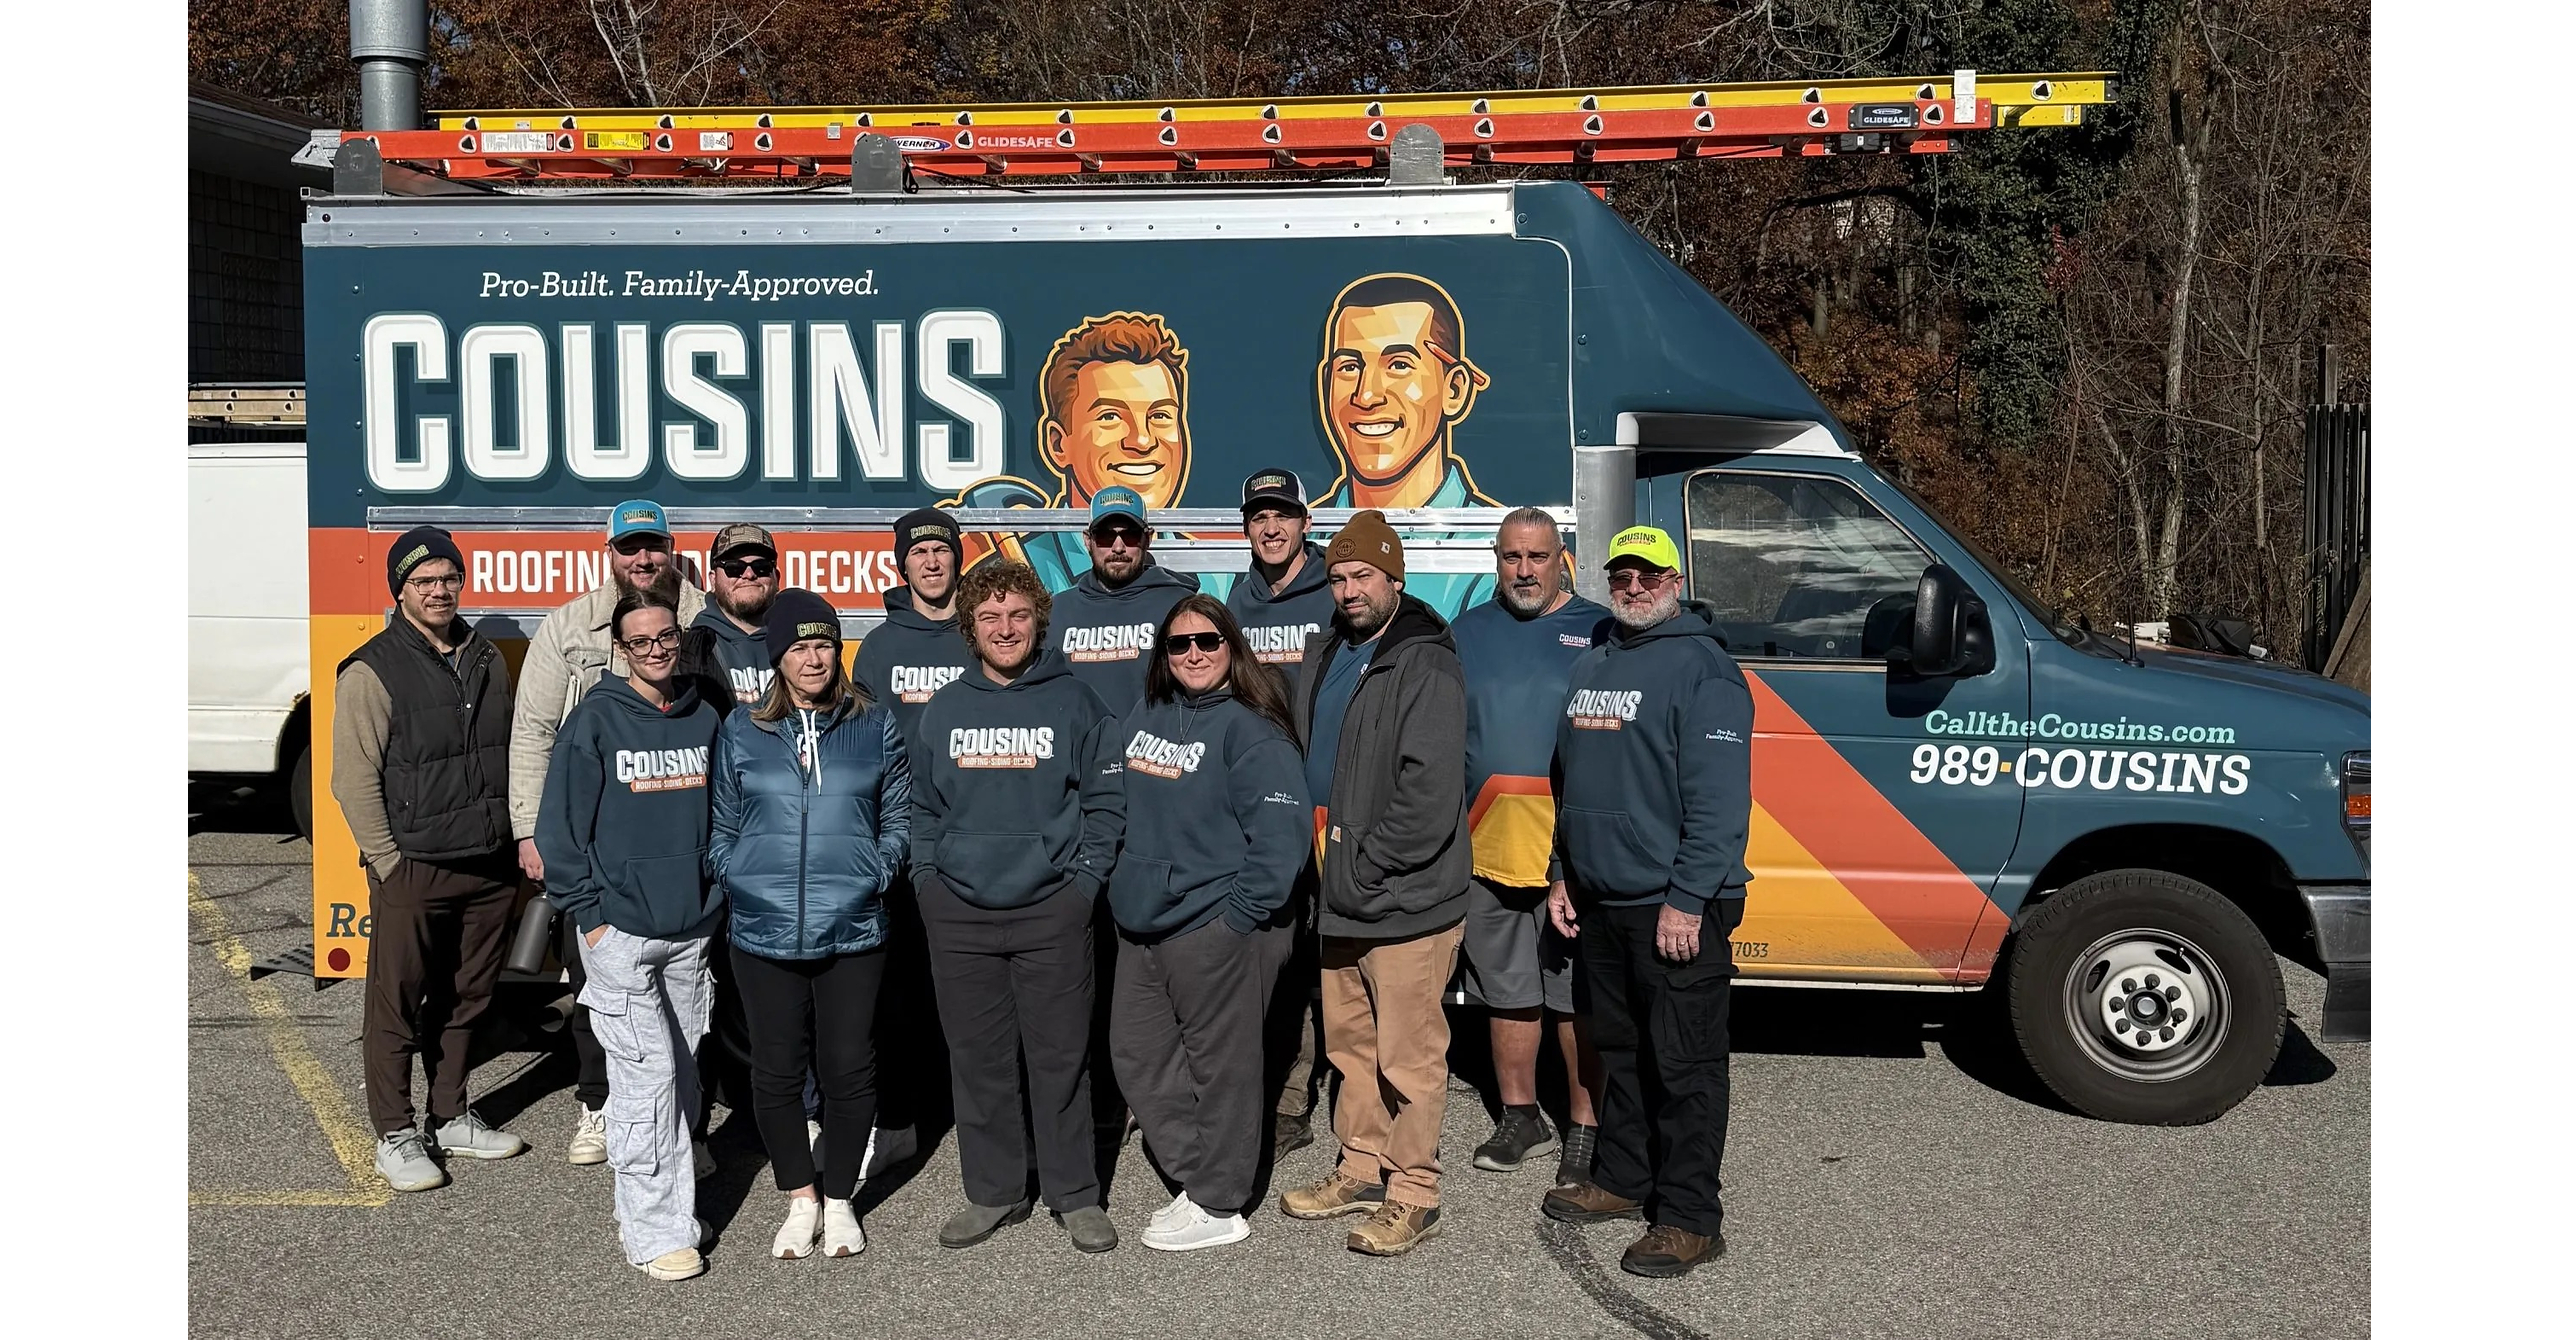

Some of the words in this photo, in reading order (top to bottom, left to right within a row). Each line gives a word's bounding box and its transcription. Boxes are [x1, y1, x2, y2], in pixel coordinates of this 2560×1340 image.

[1863, 116, 1909, 124] GLIDESAFE
[977, 136, 1053, 148] GLIDESAFE
[479, 270, 614, 297] Pro-Built.
[622, 270, 879, 301] Family-Approved.
[362, 309, 1006, 493] COUSINS
[785, 550, 899, 593] DECKS
[1062, 622, 1156, 653] COUSINS
[1559, 633, 1591, 645] COUSINS
[891, 665, 966, 694] COUSI
[1566, 688, 1643, 722] COUSINS
[1924, 709, 2236, 744] CalltheCousins.com
[949, 727, 1055, 759] COUSINS
[1125, 730, 1206, 773] COUSINS
[616, 745, 709, 783] COUSINS
[1731, 941, 1769, 957] 7033
